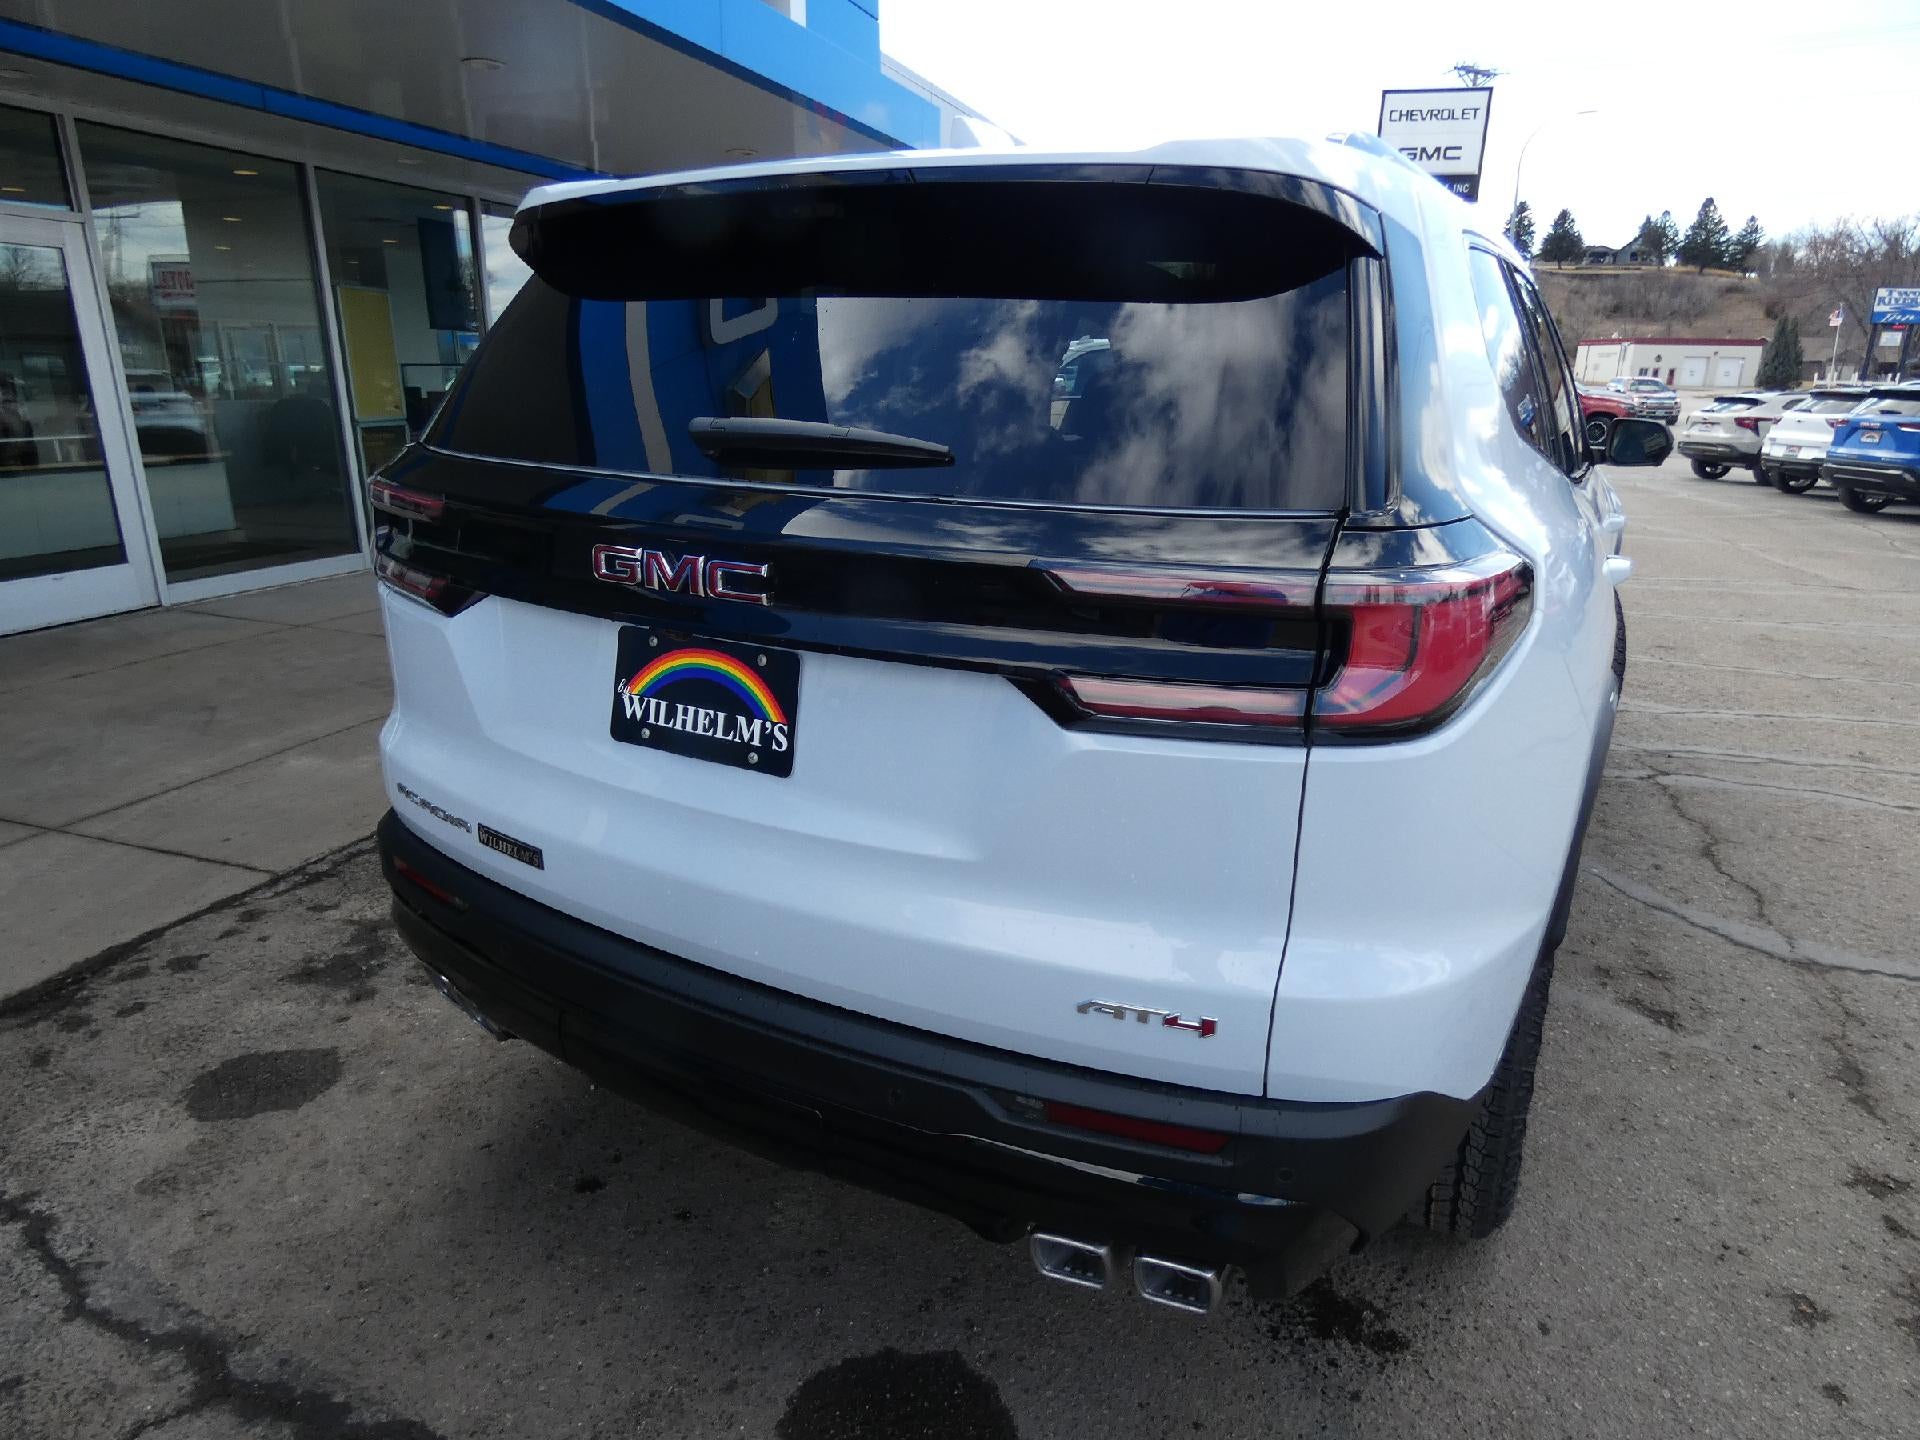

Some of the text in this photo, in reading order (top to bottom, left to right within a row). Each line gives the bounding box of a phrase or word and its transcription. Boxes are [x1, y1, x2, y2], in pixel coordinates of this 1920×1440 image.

[1389, 108, 1480, 122] CHEVROLET
[1399, 146, 1462, 161] GMC
[1453, 183, 1470, 193] INC
[1877, 297, 1920, 308] RIVER
[592, 543, 775, 606] GMC
[622, 693, 789, 752] WILHELM'S
